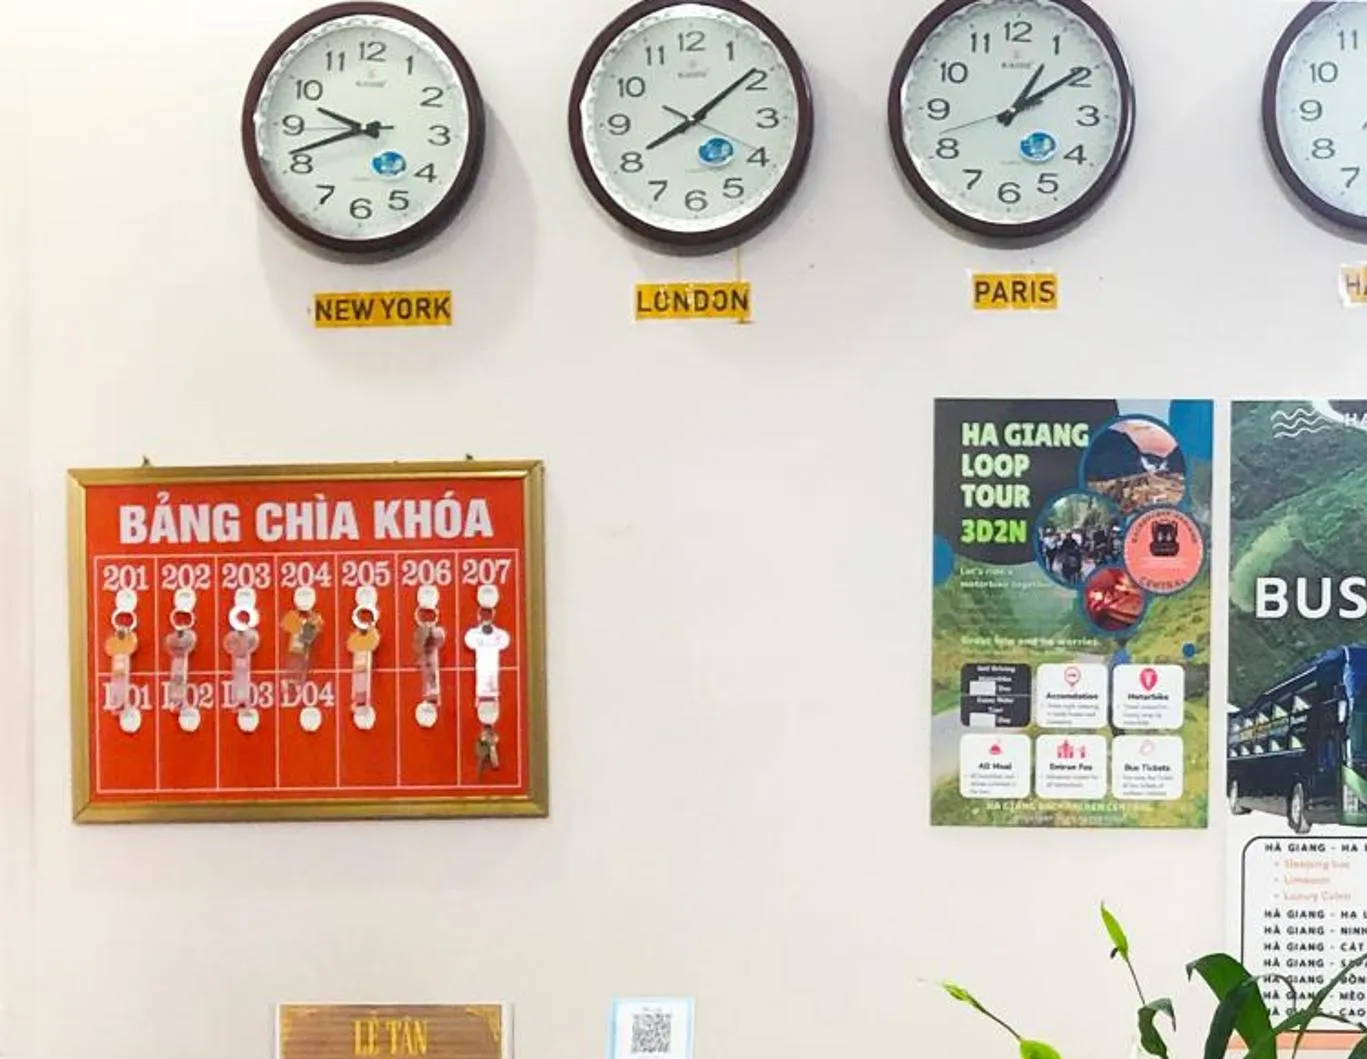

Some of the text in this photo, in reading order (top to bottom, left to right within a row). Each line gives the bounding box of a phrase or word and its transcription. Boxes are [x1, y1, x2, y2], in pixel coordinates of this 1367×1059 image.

[678, 31, 706, 52] 12
[970, 32, 991, 53] 11
[1004, 21, 1033, 43] 12
[1338, 29, 1358, 51] 11
[359, 41, 387, 62] 12
[645, 45, 665, 66] 11
[725, 40, 735, 61] 1
[1052, 35, 1061, 55] 1
[325, 50, 346, 72] 11
[405, 55, 414, 75] 1
[745, 69, 768, 91] 2
[940, 62, 969, 84] 10
[1068, 66, 1092, 88] 2
[1309, 62, 1338, 84] 10
[295, 79, 323, 101] 10
[420, 86, 445, 108] 2
[618, 76, 646, 98] 10
[756, 108, 780, 129] 3
[927, 98, 950, 120] 9
[1076, 105, 1101, 127] 3
[1299, 99, 1323, 122] 9
[282, 114, 306, 136] 9
[428, 125, 451, 146] 3
[607, 114, 631, 135] 9
[747, 147, 770, 167] 4
[936, 138, 960, 159] 8
[1063, 144, 1087, 165] 4
[1311, 138, 1336, 160] 8
[290, 153, 314, 175] 8
[414, 163, 438, 183] 4
[620, 152, 644, 173] 8
[722, 177, 745, 199] 5
[962, 169, 983, 191] 7
[1037, 173, 1060, 194] 5
[1340, 167, 1361, 188] 7
[315, 184, 336, 205] 7
[388, 190, 410, 211] 5
[648, 180, 668, 201] 7
[684, 190, 708, 212] 6
[998, 182, 1021, 204] 6
[350, 198, 373, 220] 6
[637, 289, 749, 313] LONDON
[975, 280, 1055, 303] PARIS
[315, 296, 451, 322] NEW YORK
[961, 422, 1090, 447] HA GIANG
[961, 453, 1031, 478] LOOP
[960, 484, 1031, 508] TOUR
[118, 490, 494, 544] BẢNG CHÌA KHÓA
[961, 519, 1027, 544] 3D2N
[102, 563, 149, 592] 201
[161, 563, 211, 590] 202
[222, 562, 272, 589] 203
[280, 561, 332, 588] 204
[342, 560, 391, 587] 205
[401, 559, 451, 586] 206
[462, 558, 512, 585] 207
[1288, 843, 1326, 852] GIANG
[1286, 910, 1325, 919] GIANG
[1286, 926, 1325, 935] GIANG
[1286, 942, 1325, 951] GIANG
[1286, 958, 1325, 967] GIANG
[1286, 974, 1325, 983] GIANG
